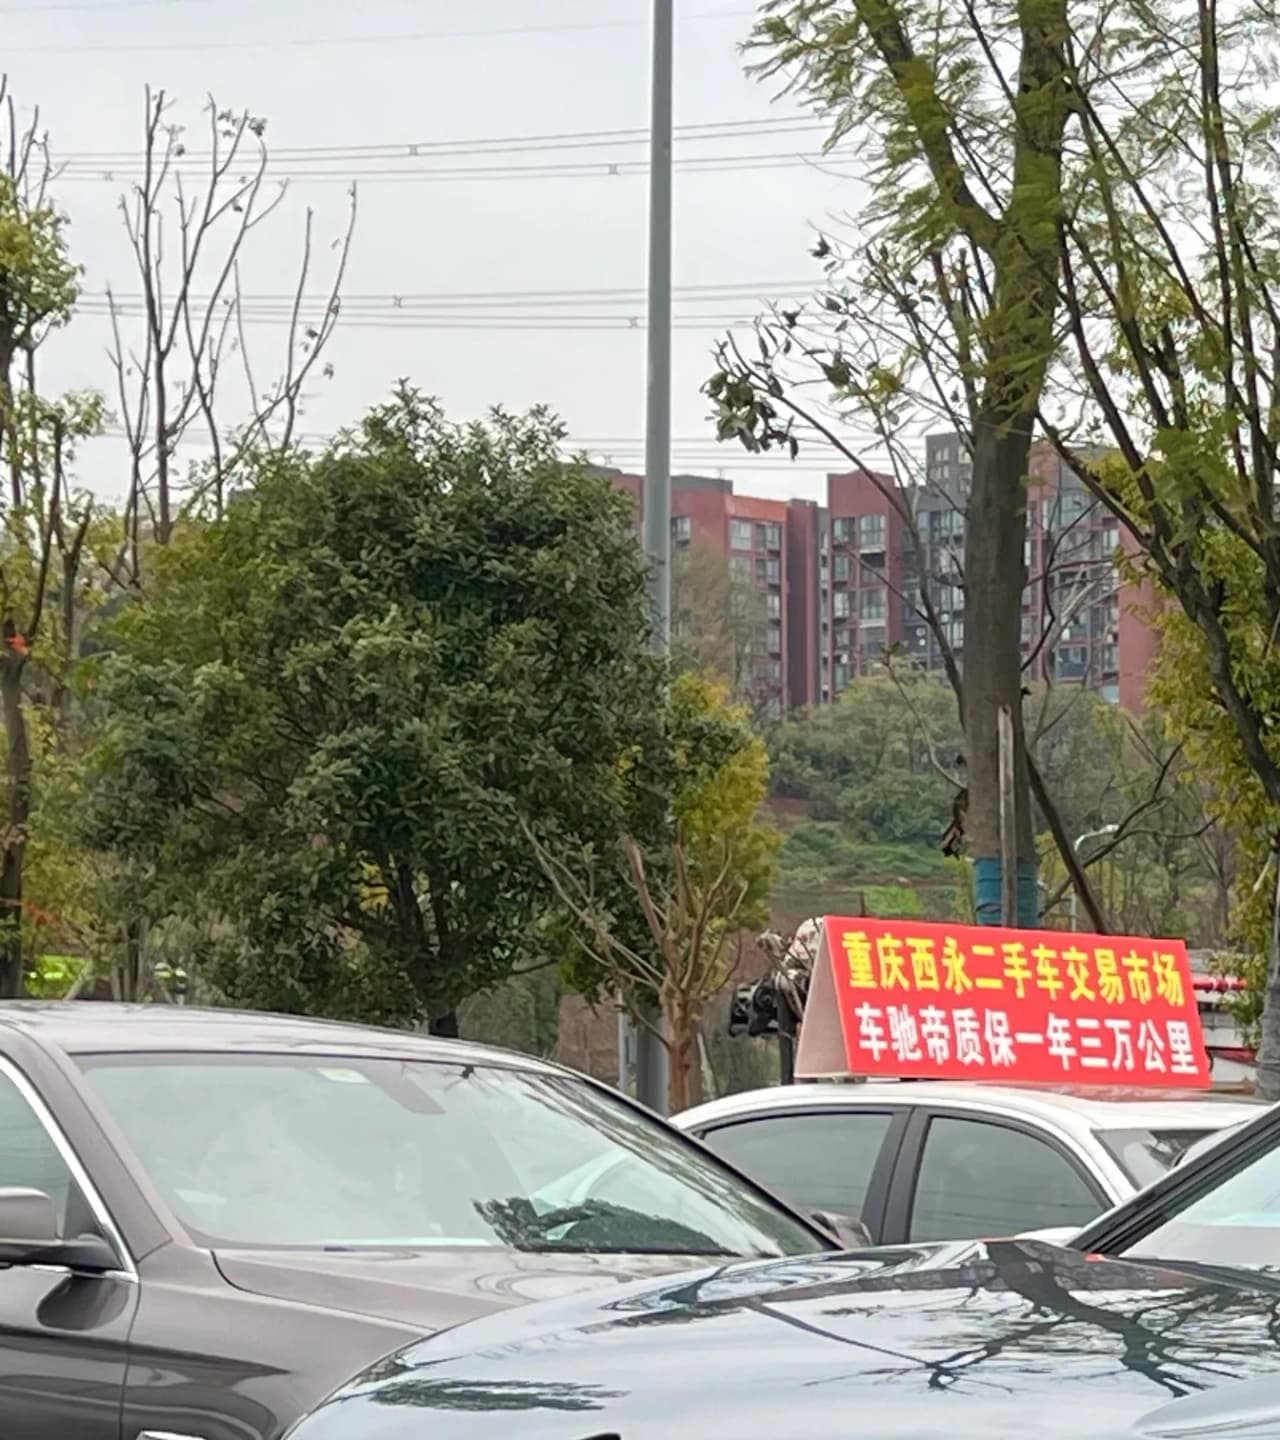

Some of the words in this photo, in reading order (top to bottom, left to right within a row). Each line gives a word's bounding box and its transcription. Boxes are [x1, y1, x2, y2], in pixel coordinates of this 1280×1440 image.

[841, 931, 1185, 1007] 重庆西永二手车交易市场
[854, 1002, 1199, 1075] 车驰帝质保一年三万公里
